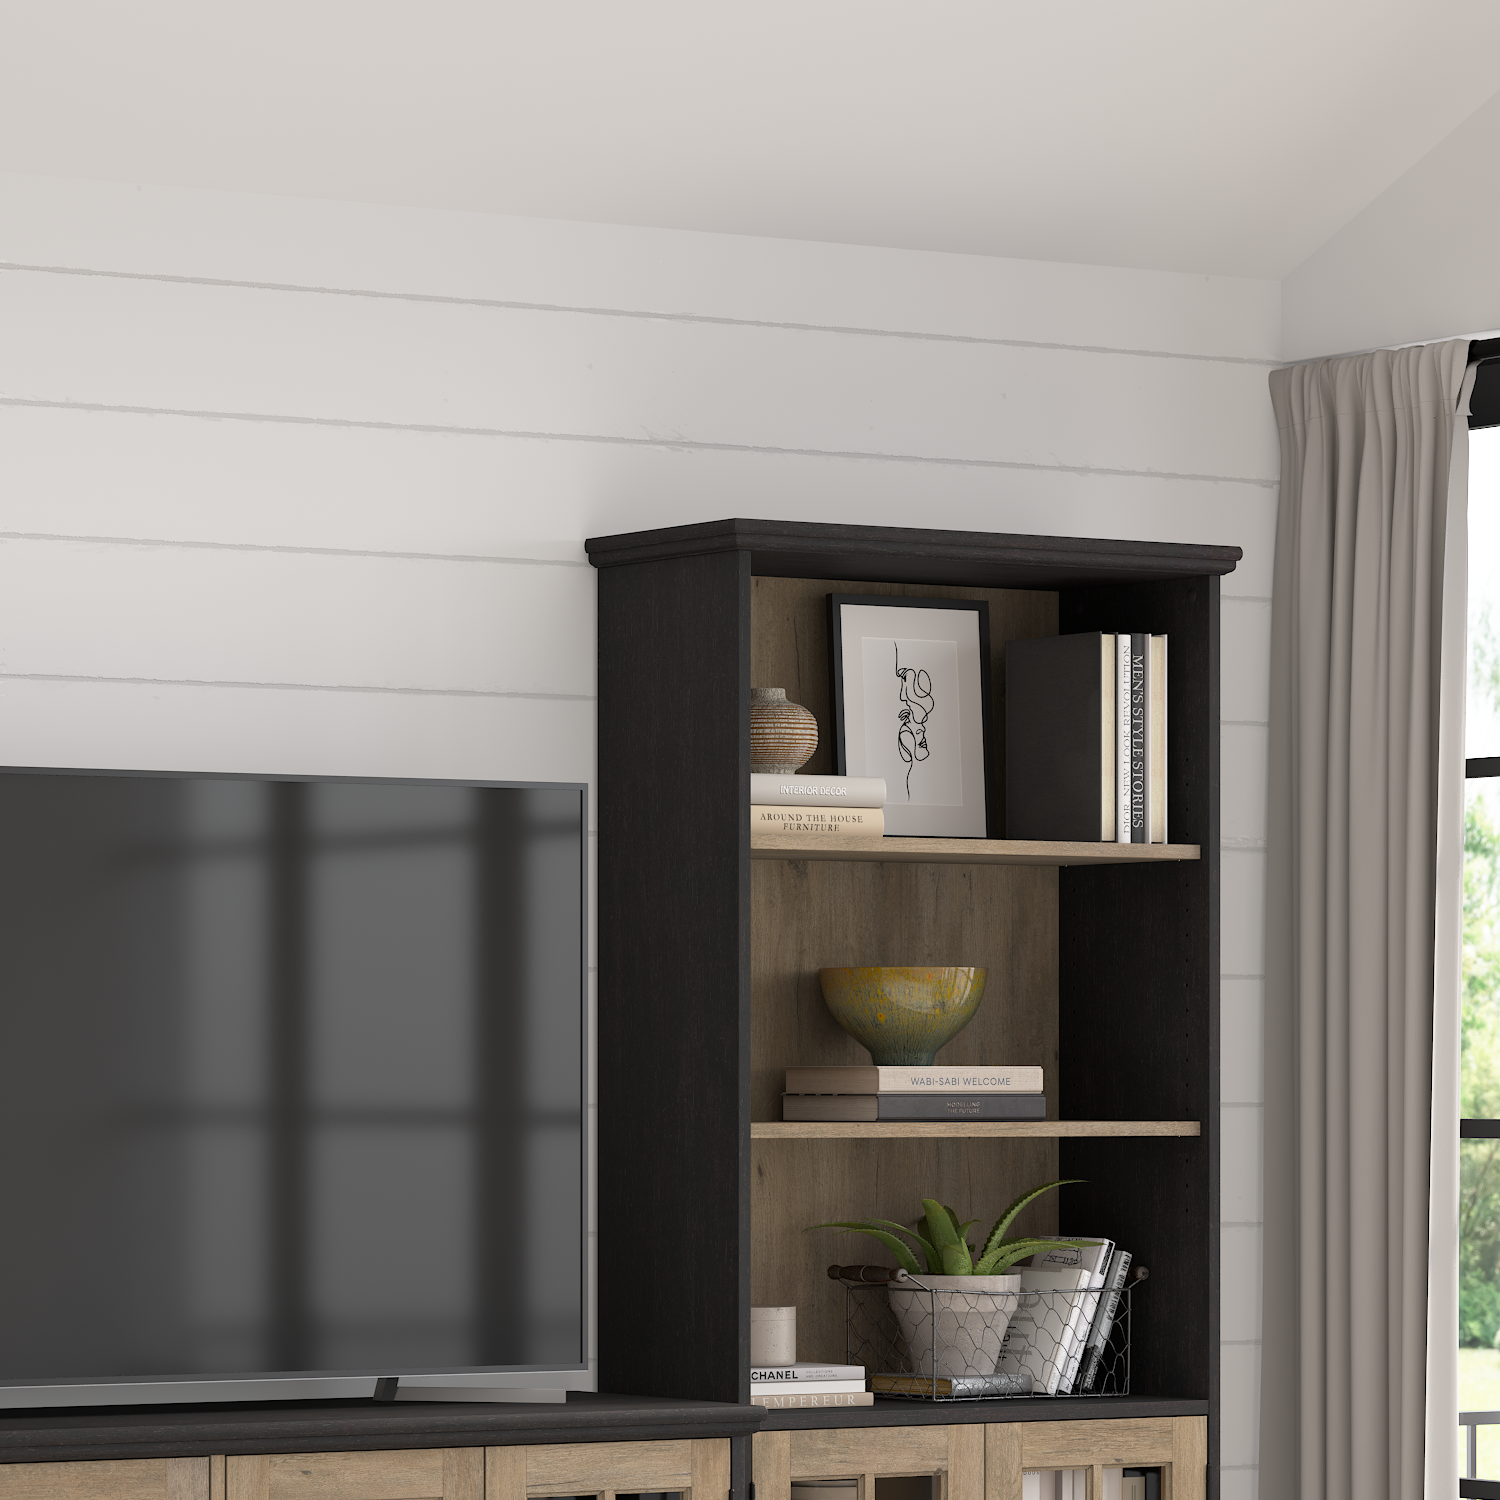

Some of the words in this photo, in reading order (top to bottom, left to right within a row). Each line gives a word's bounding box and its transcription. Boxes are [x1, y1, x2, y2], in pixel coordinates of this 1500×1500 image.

[1123, 645, 1131, 726] REVOLUTION
[1132, 654, 1144, 704] MEN'S
[1123, 730, 1131, 764] LOOK
[1132, 707, 1144, 758] STYLE
[780, 785, 818, 796] INTERIOR
[820, 786, 847, 797] DECOR
[1123, 768, 1131, 797] NEW
[1132, 760, 1144, 828] STORIES
[760, 813, 803, 821] AROUND
[805, 814, 827, 822] THE
[830, 815, 864, 823] HOUSE
[783, 822, 840, 832] FURNITURE
[910, 1077, 960, 1086] WABI-SABI
[962, 1077, 1011, 1086] WELCOME
[751, 1370, 798, 1381] CHANEL
